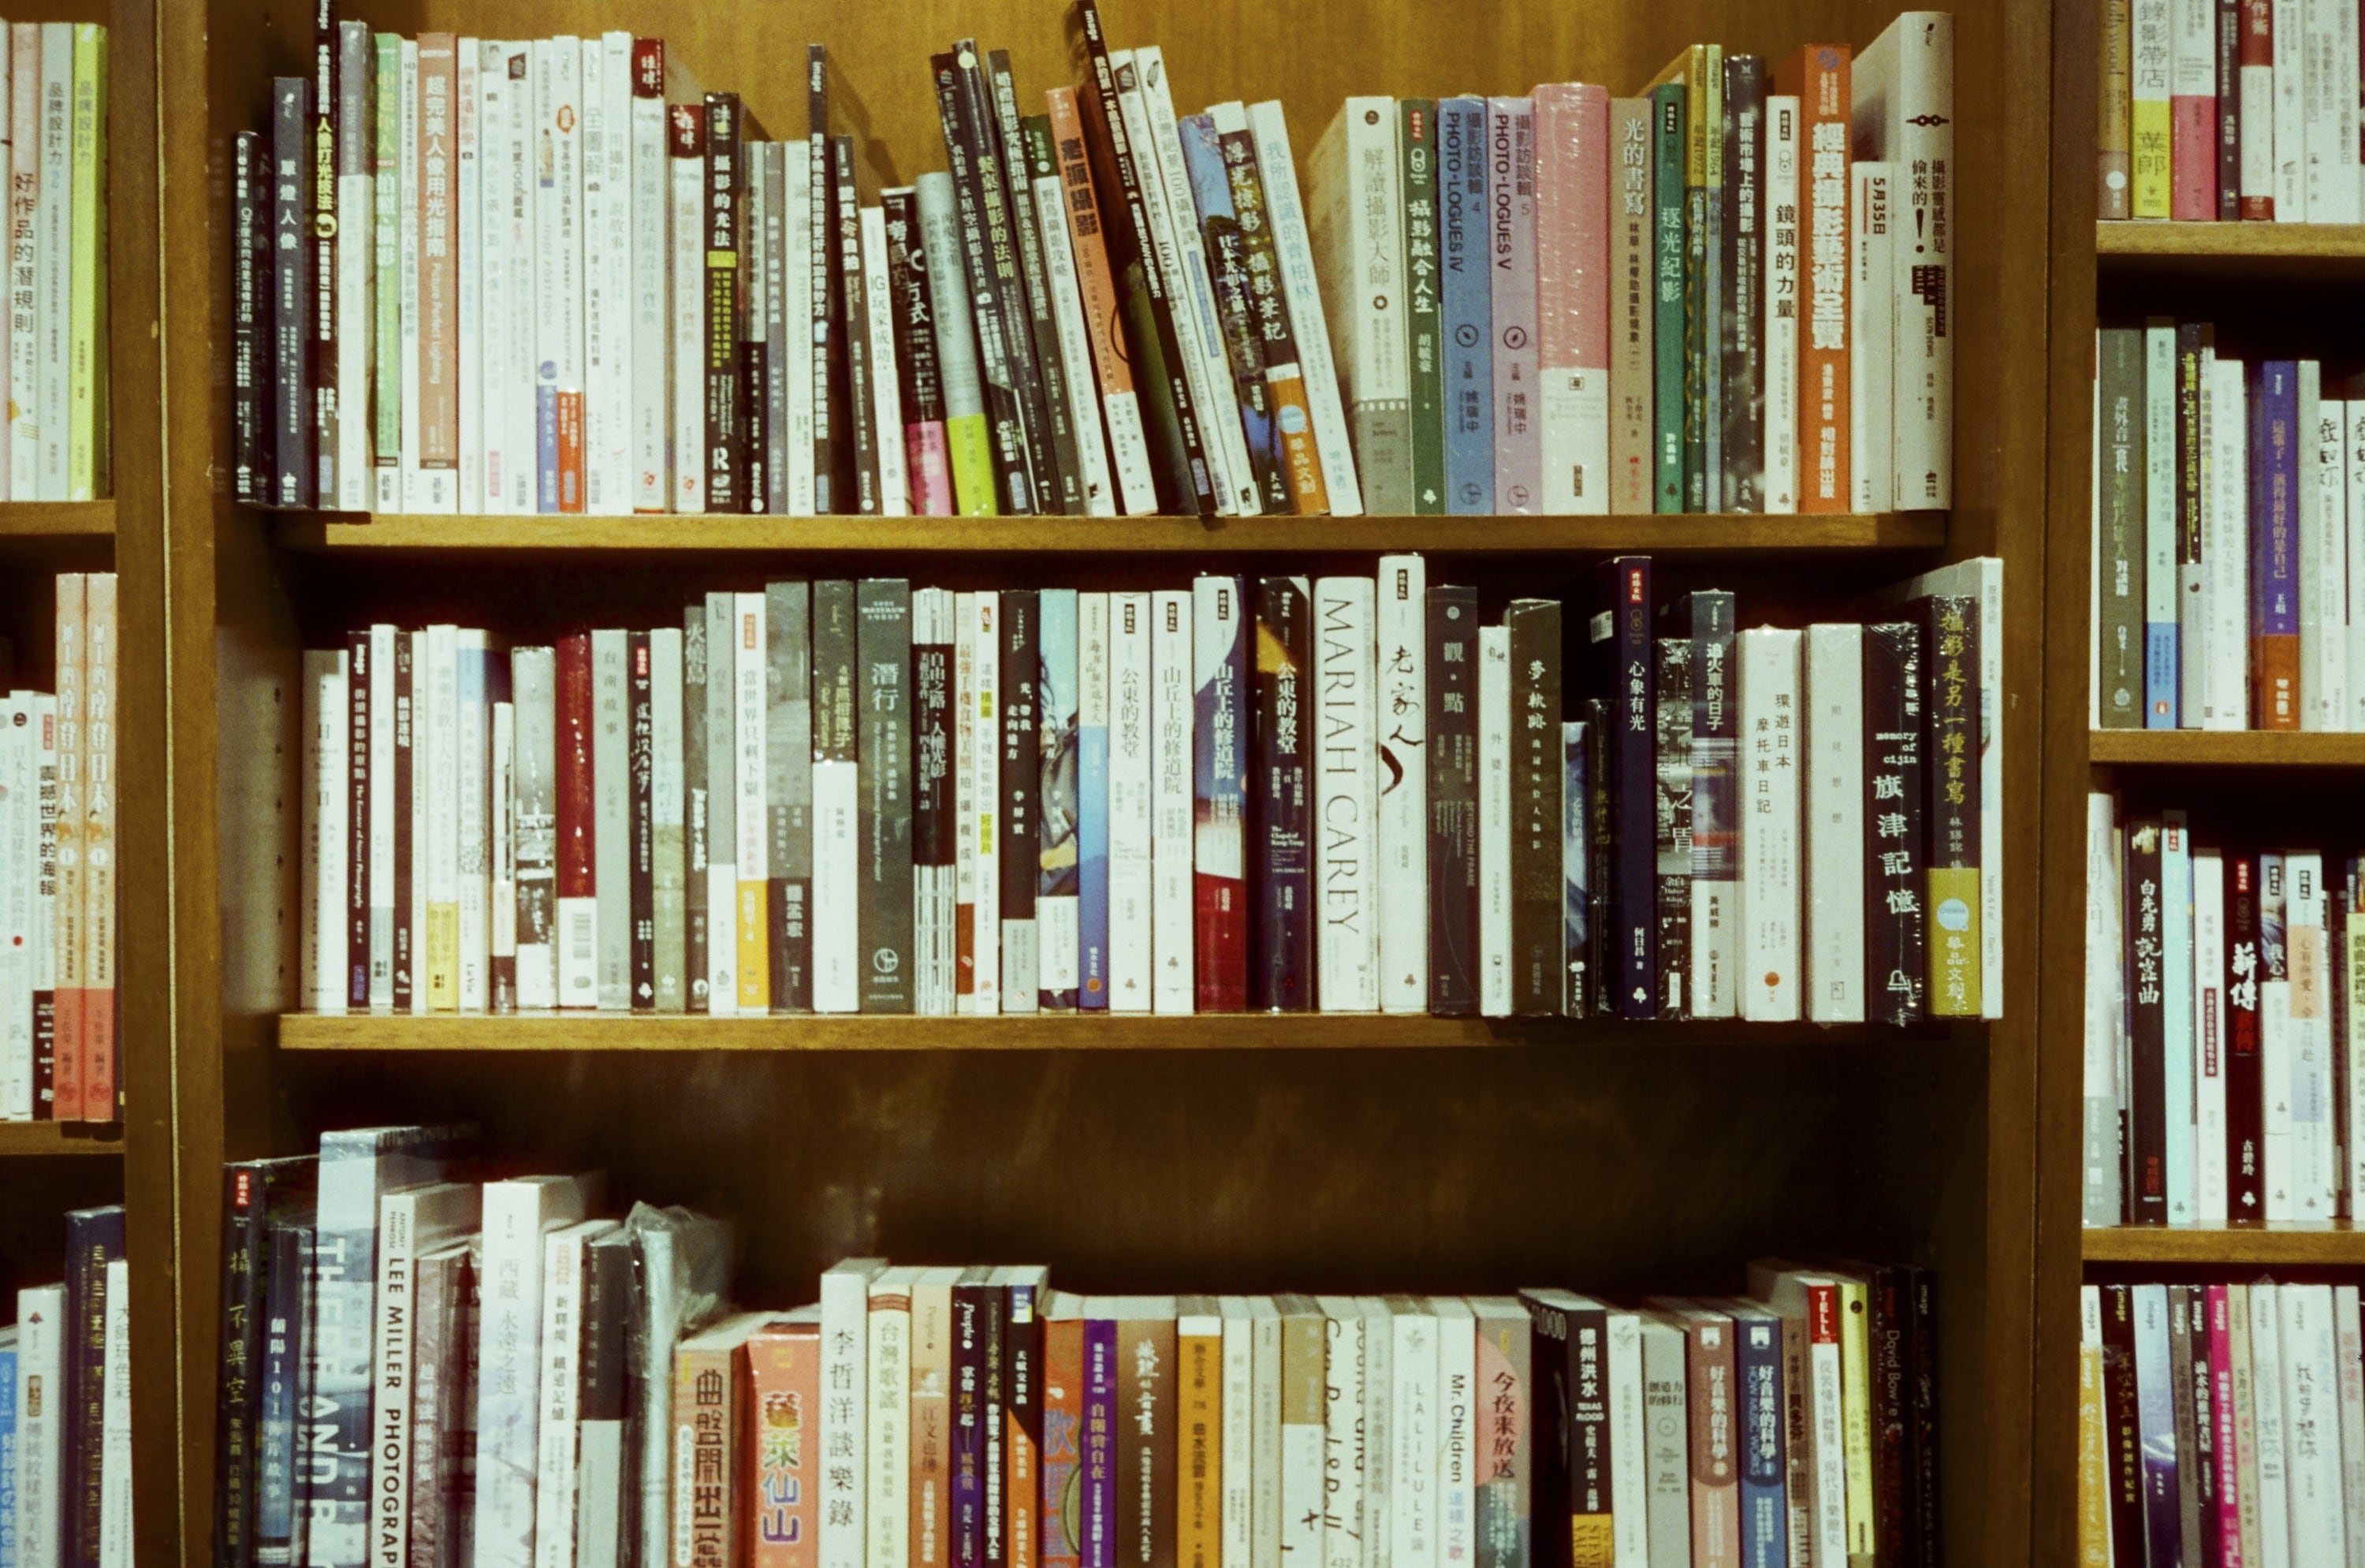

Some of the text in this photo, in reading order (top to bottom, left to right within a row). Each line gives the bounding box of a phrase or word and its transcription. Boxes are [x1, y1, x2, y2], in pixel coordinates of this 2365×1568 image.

[1623, 118, 1645, 216] 光的書寫
[1872, 177, 1886, 235] 5月35日
[1661, 206, 1683, 304] 逐光紀影
[1775, 203, 1796, 319] 鏡頭的力量
[871, 662, 899, 712] 潛行
[1121, 667, 1139, 759] 公東的教堂
[1163, 665, 1182, 795] 山丘上的修道院
[1214, 663, 1236, 780] 山丘上的修道院
[1276, 662, 1298, 754] 公東的教堂
[1629, 661, 1646, 732] 心象有光
[1707, 642, 1724, 732] 追火車的日子
[1774, 693, 1792, 769] 環遊日本
[1940, 611, 1968, 806] 攝影是另一種書寫
[1324, 598, 1360, 935] MARIAH CAREY
[1755, 717, 1772, 815] 摩托車日記
[1875, 731, 1917, 743] memory
[1883, 754, 1918, 766] cijin
[1902, 744, 1917, 754] of
[1873, 773, 1920, 915] 旗津記憶
[386, 1257, 405, 1390] LEE MILLER
[1818, 1291, 1830, 1335] TELL
[1886, 1330, 1901, 1367] David
[762, 1391, 803, 1544] 蓬萊仙山
[829, 1328, 855, 1528] 李哲洋談樂錄
[1450, 1373, 1466, 1483] Mr. Children
[1491, 1370, 1517, 1480] 今夜來放送
